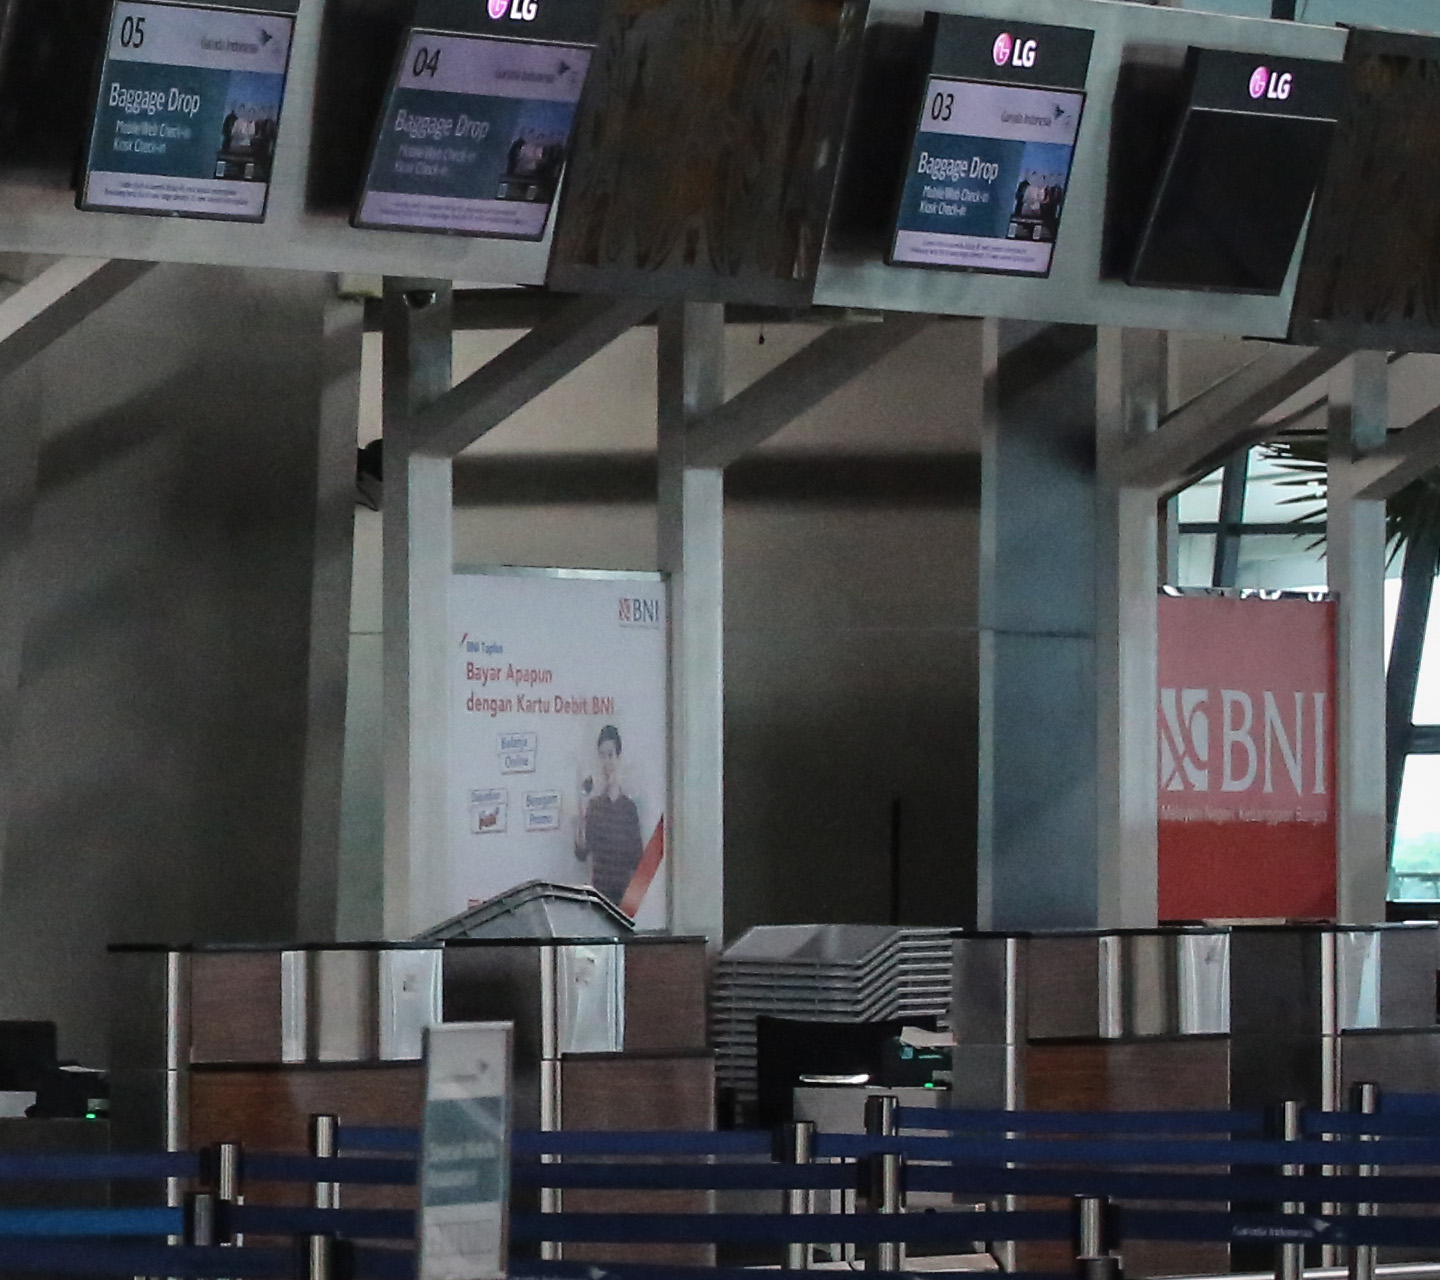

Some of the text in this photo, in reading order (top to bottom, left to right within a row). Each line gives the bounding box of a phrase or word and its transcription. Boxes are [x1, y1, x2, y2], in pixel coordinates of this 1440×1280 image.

[121, 16, 145, 48] 05
[413, 47, 441, 77] 04
[1012, 37, 1037, 69] LG
[109, 83, 200, 118] Baggage Drop
[1267, 71, 1292, 100] LG
[931, 92, 954, 121] 03
[395, 109, 490, 141] Baggage Drop
[918, 152, 998, 184] Baggage Drop
[633, 599, 658, 622] BNI
[467, 662, 552, 686] Bayar Apapun
[467, 692, 614, 717] dengan Kartu Debit BNI
[1221, 689, 1327, 796] BNI
